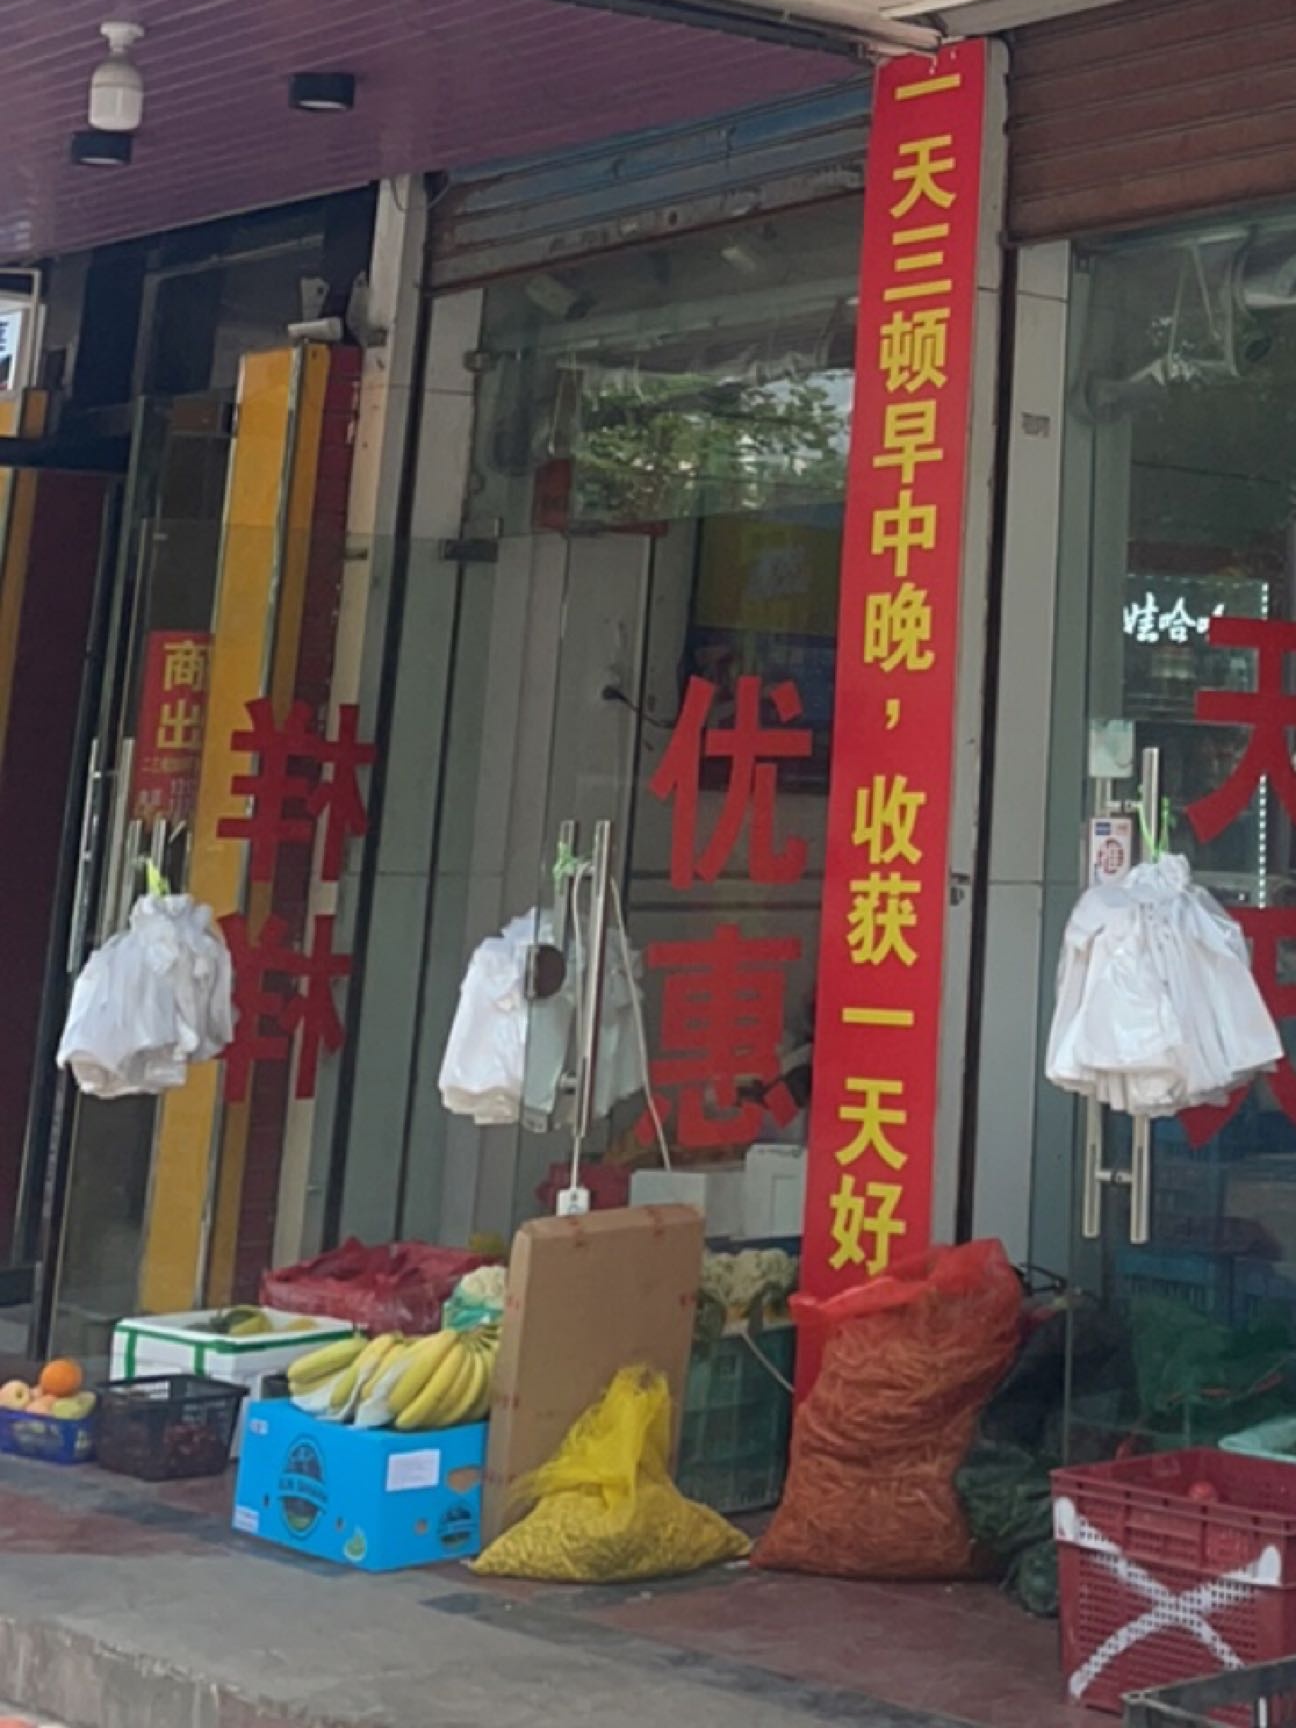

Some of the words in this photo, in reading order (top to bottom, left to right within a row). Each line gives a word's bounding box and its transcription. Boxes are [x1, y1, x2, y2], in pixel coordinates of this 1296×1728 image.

[633, 674, 813, 1149] 优惠
[828, 72, 962, 1276] 一天三顿早中晚，收获一天好
